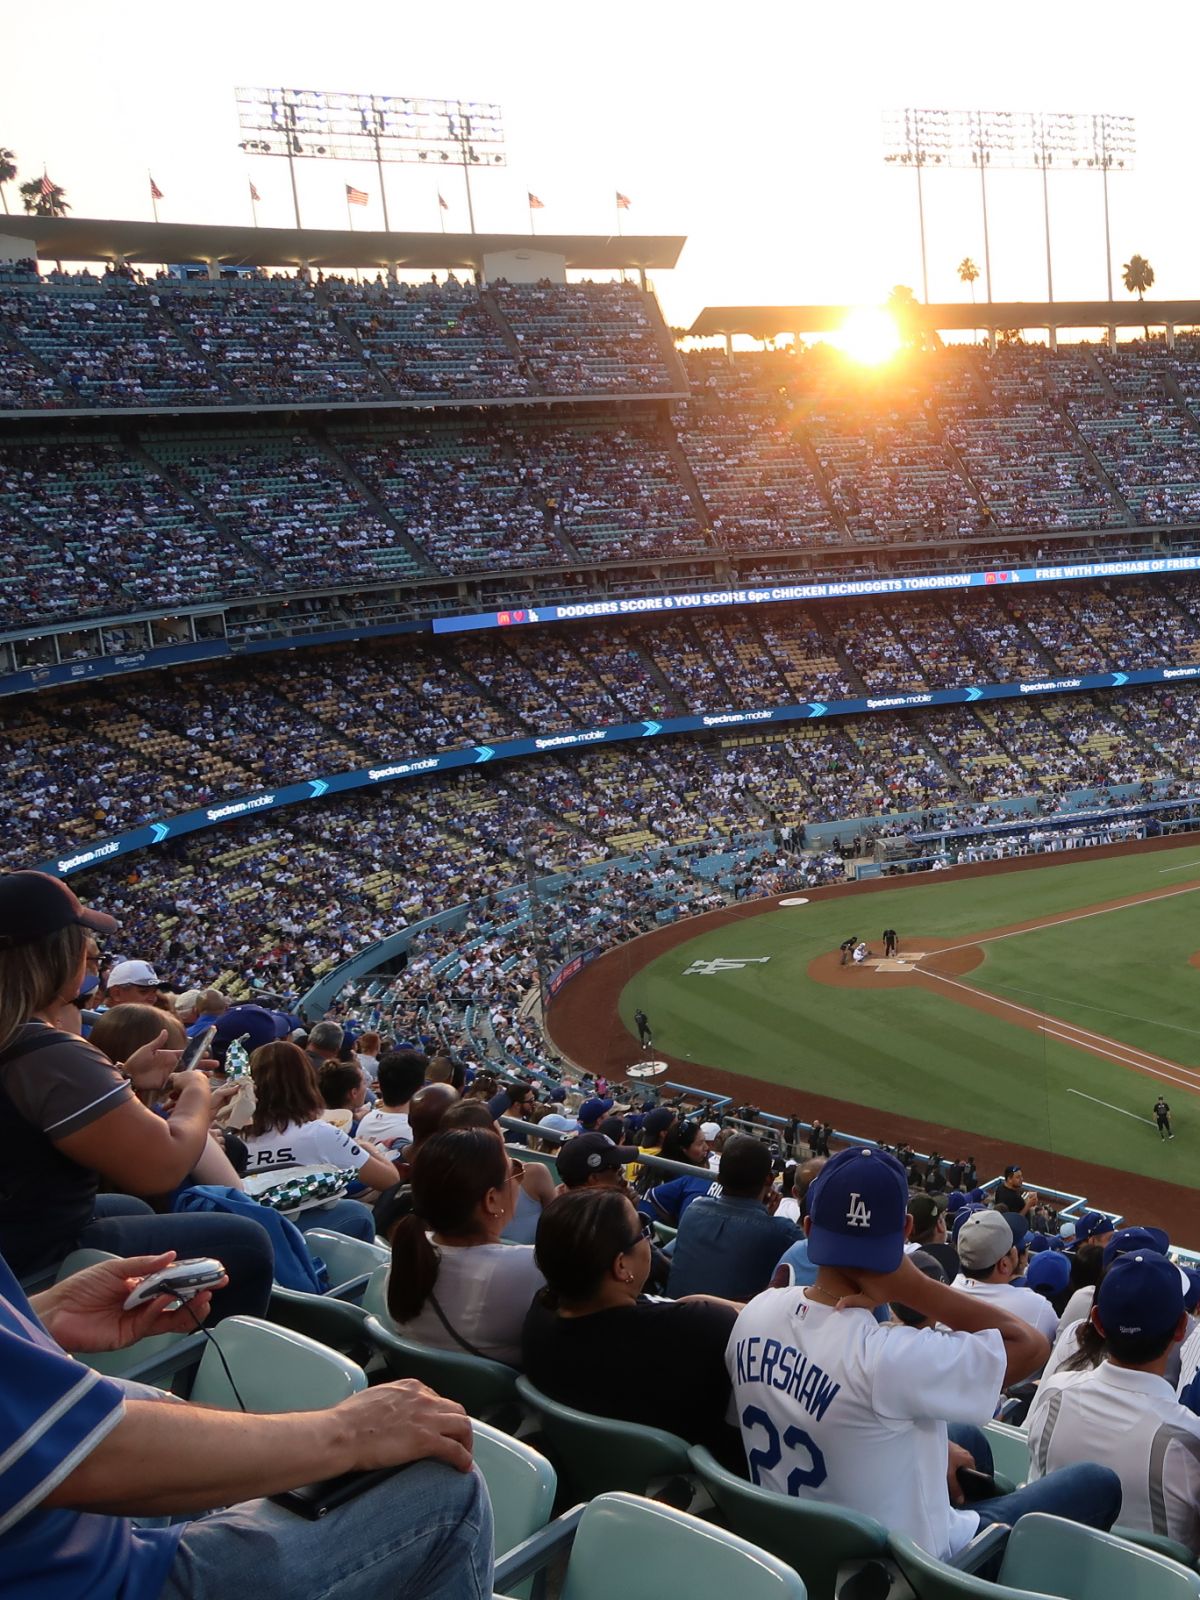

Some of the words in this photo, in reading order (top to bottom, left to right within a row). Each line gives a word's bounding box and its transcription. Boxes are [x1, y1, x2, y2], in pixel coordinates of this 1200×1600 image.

[1036, 568, 1063, 579] FREE
[1064, 566, 1093, 578] WITH
[1094, 561, 1150, 576] PURCHASE
[1151, 560, 1166, 570] OF
[1167, 557, 1196, 569] FRIES
[557, 601, 618, 618] DODGERS
[619, 597, 663, 612] SCORE
[664, 598, 673, 609] 6
[673, 595, 701, 608] YOU
[703, 591, 746, 605] SCORE
[747, 590, 771, 603] 6pc
[771, 585, 827, 600] CHICKEN
[828, 579, 903, 595] MCNUGGETS
[903, 575, 972, 590] TOMORROW
[1163, 667, 1197, 679] Spectrum
[1019, 682, 1057, 694] Spectrum
[1057, 678, 1081, 688] mobile
[867, 697, 906, 709] Spectrum
[906, 694, 932, 704] mobile
[703, 713, 745, 727] Spectrum
[745, 710, 772, 721] mobile
[535, 734, 577, 749] Spectrum
[578, 731, 606, 742] mobile
[368, 764, 410, 781] Spectrum
[410, 758, 438, 771] mobile
[207, 802, 246, 821] Spectrum
[247, 795, 274, 809] mobile
[57, 851, 95, 873] Spectrum
[94, 841, 119, 859] mobile
[846, 1192, 871, 1228] LA
[736, 1336, 841, 1423] KERSHAW
[742, 1403, 828, 1498] 22
